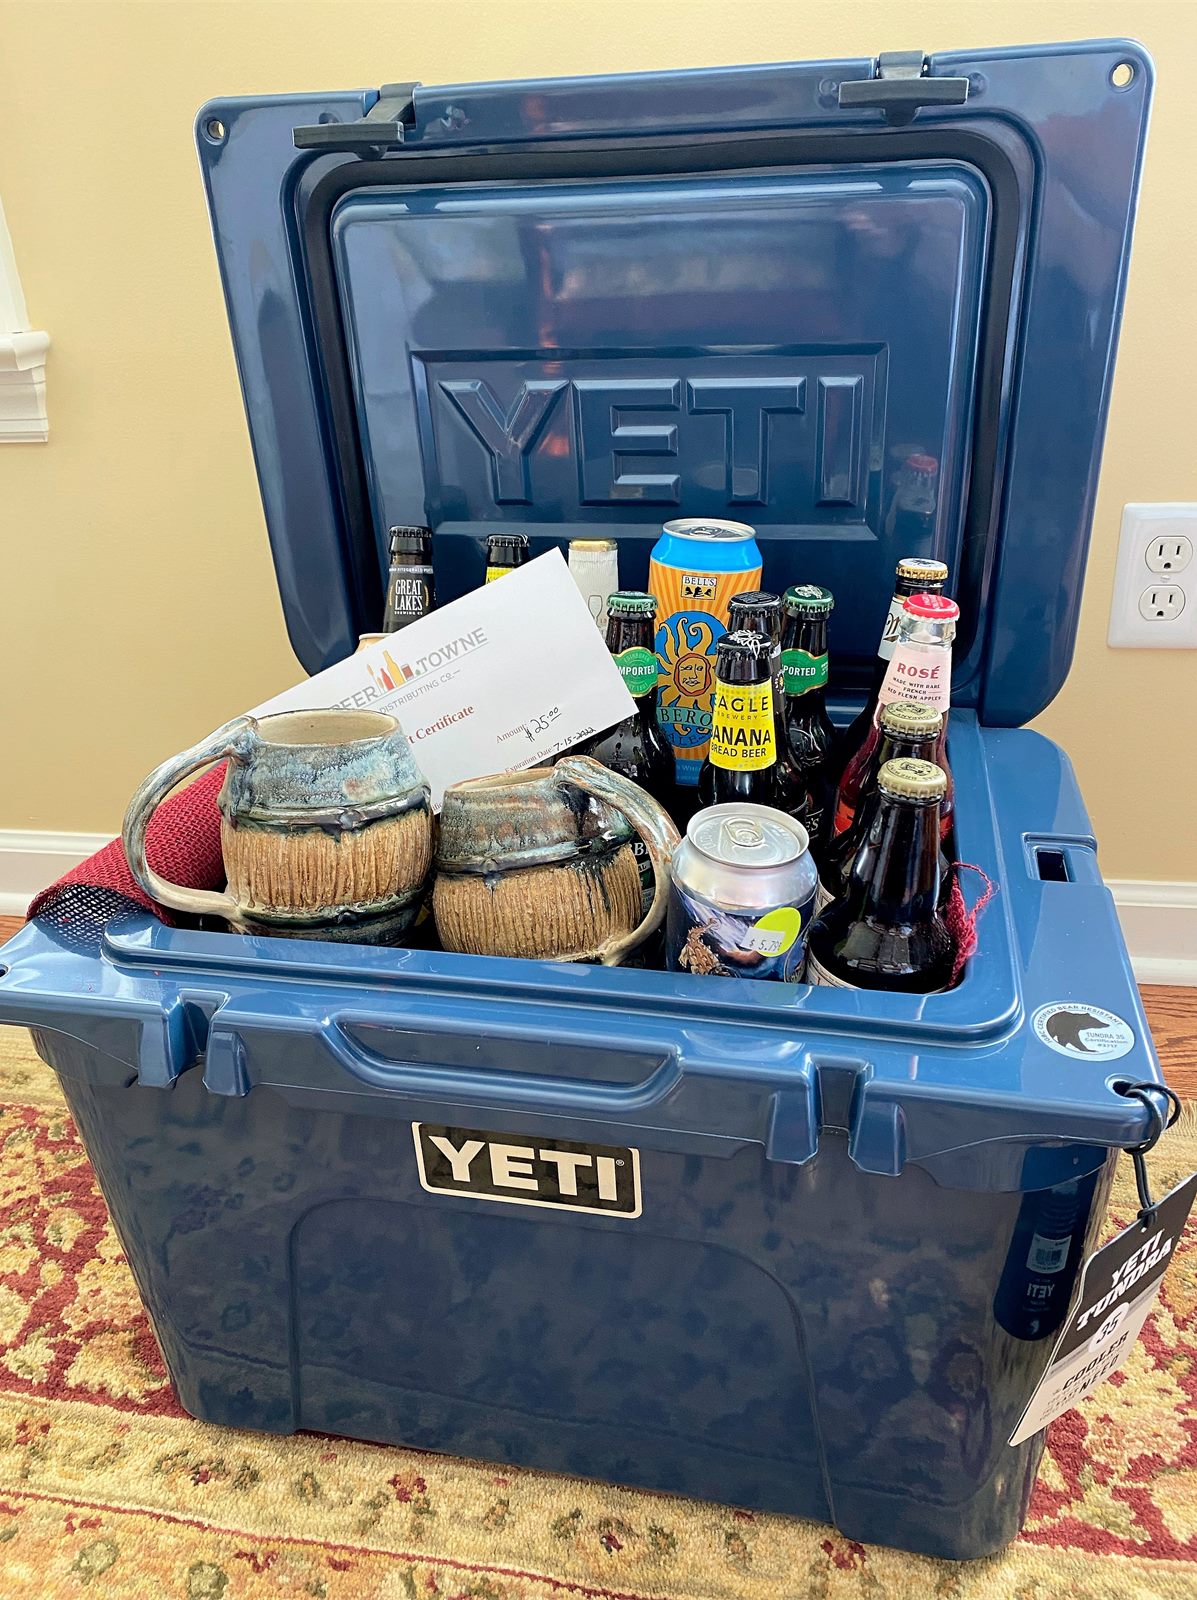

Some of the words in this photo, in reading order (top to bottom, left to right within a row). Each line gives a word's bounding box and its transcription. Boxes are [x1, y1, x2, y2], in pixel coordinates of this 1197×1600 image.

[437, 375, 864, 507] YETI
[395, 579, 422, 595] GREAT
[684, 576, 715, 586] BELL'S
[394, 595, 423, 611] LAKES
[415, 627, 488, 674] TOWNE
[618, 664, 655, 676] MPORTED
[783, 664, 816, 677] PORTED
[897, 662, 941, 679] ROSÉ
[379, 679, 440, 714] DISTRIBUTING
[716, 695, 769, 712] AGLE
[415, 705, 475, 741] Certificate
[660, 708, 713, 727] BERO
[712, 725, 771, 747] ANANA
[741, 748, 766, 758] BEER
[505, 755, 537, 775] Expiration
[428, 1135, 618, 1202] YETI
[1111, 1229, 1165, 1288] YETI
[1076, 1237, 1173, 1331] TUNDRA
[1096, 1311, 1123, 1344] 35
[1063, 1330, 1130, 1390] COOLER
